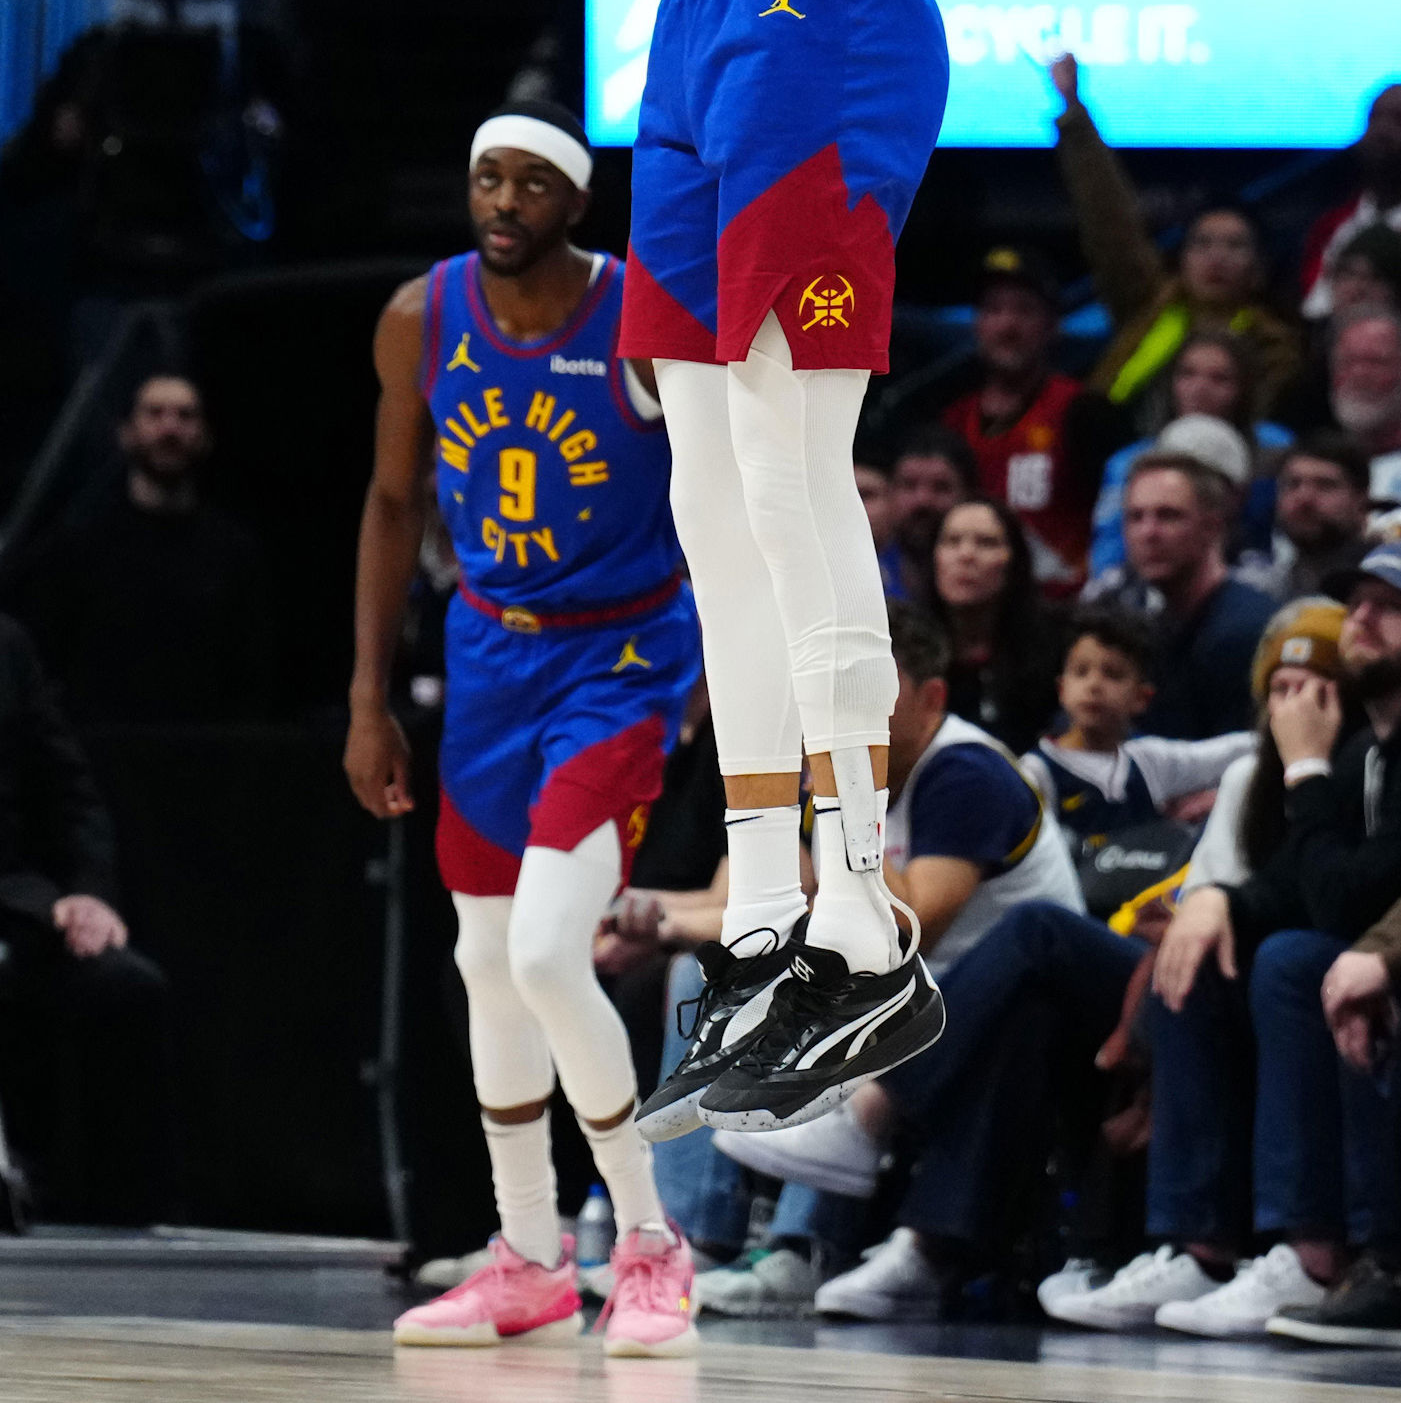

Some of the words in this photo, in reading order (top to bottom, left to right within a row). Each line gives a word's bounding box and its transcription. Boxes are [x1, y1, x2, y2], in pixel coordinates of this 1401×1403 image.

[551, 354, 606, 376] ibotta
[439, 387, 510, 473] MILE
[525, 391, 610, 487] HIGH
[499, 447, 536, 522] 9
[482, 517, 560, 567] CITY
